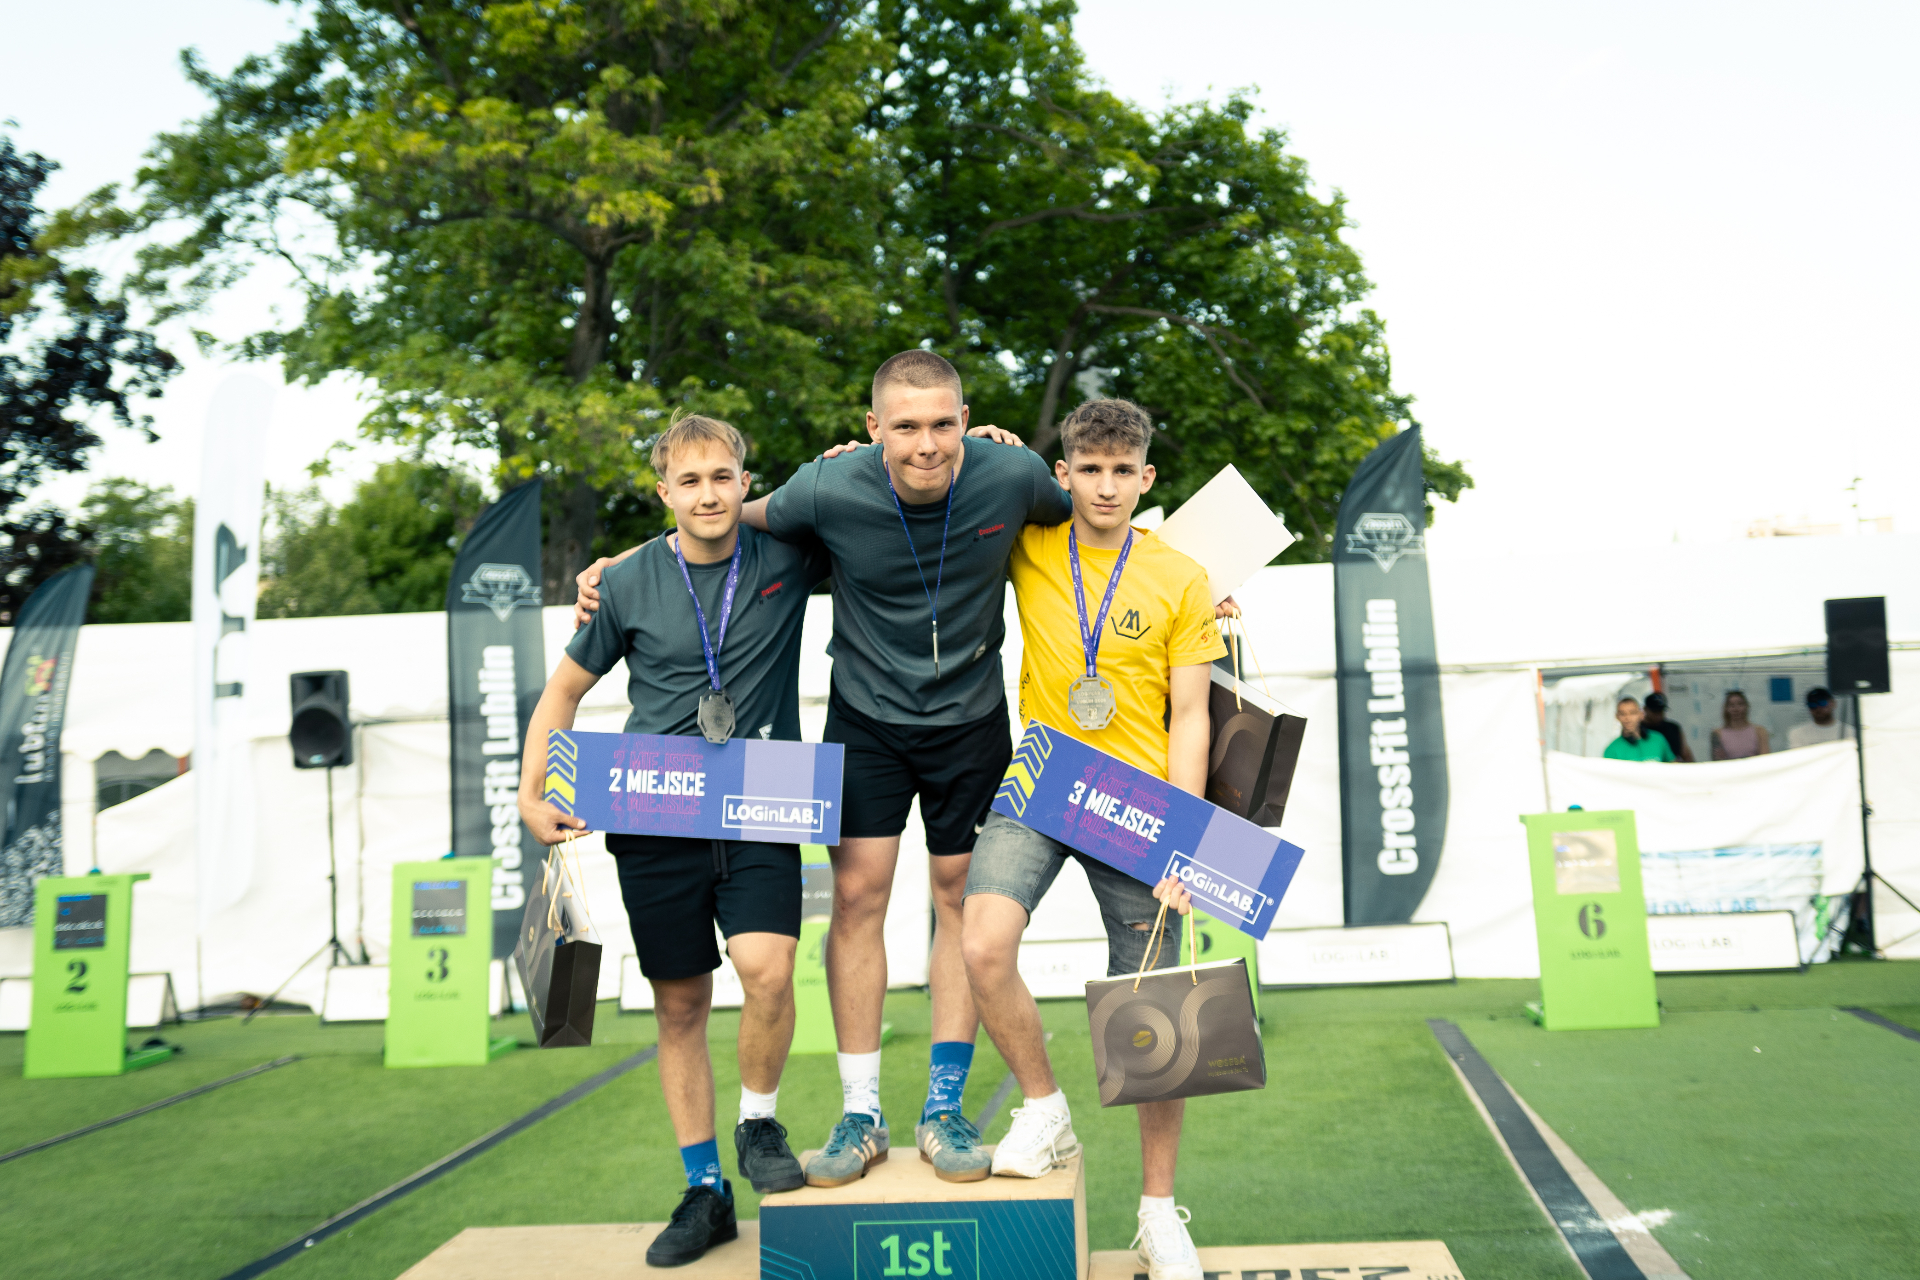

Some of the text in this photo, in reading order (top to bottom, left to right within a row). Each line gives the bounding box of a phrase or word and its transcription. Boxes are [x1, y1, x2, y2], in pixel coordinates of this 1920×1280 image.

[1362, 599, 1405, 713] Lublin
[478, 645, 520, 755] Lublin
[608, 767, 706, 797] 2 MIEJSCE
[1370, 717, 1419, 875] CrossFit
[482, 758, 525, 910] CrossFit
[1068, 780, 1165, 843] 3 MIEJSCE
[1578, 902, 1607, 941] 6
[64, 957, 88, 994] 2
[426, 946, 450, 982] 3
[880, 1230, 953, 1276] 1st
